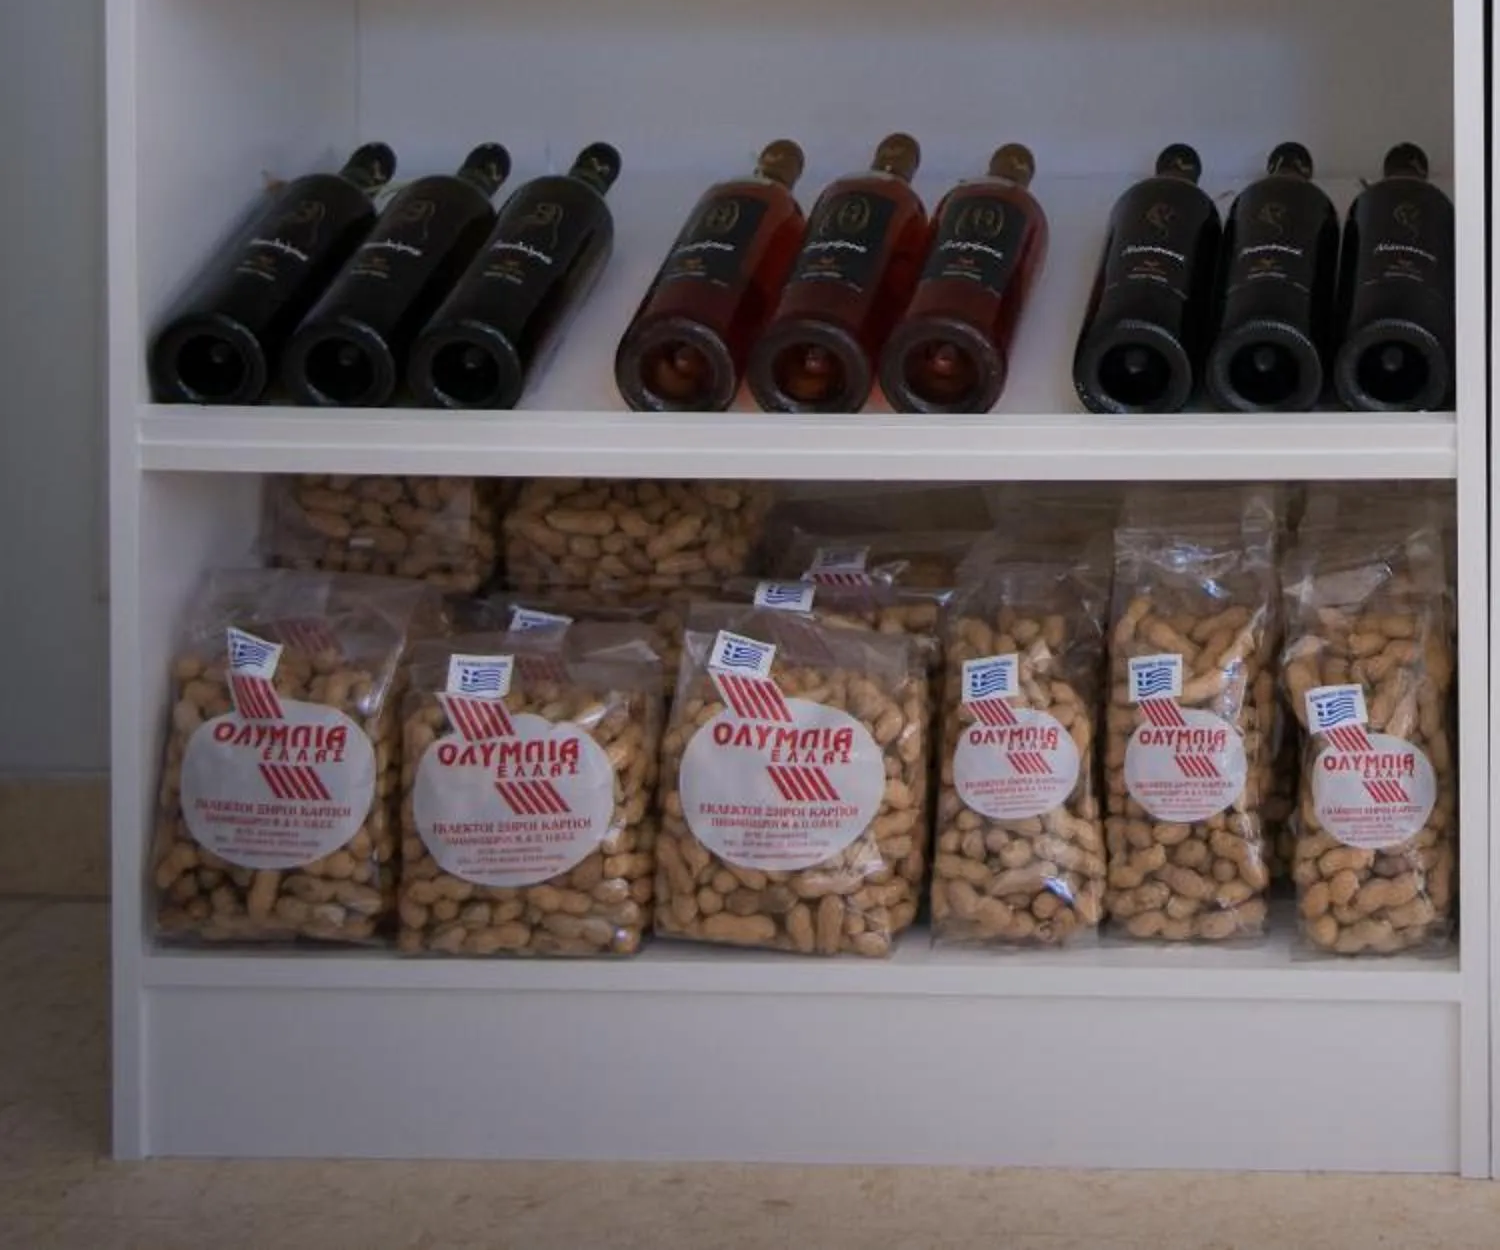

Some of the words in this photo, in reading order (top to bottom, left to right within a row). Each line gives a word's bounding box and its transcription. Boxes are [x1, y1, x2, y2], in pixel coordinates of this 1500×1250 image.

[213, 721, 347, 749] ΟΛΥΜΠΙΑ
[713, 722, 854, 753] ΟΛΥΜΠΙΑ
[968, 726, 1059, 746] ΟΛΥΜΠΙΑ
[1139, 729, 1226, 746] ΟΛΥΜΠΙΑ
[262, 749, 345, 763] ΕΛΛΑΣ
[438, 737, 580, 766] ΟΛΥΜΠΙΑ
[771, 749, 851, 763] ΕΛΛΑΣ
[497, 762, 580, 778] ΕΛΛΑΣ
[1323, 753, 1415, 771] ΟΛΥΜΠΙΑ
